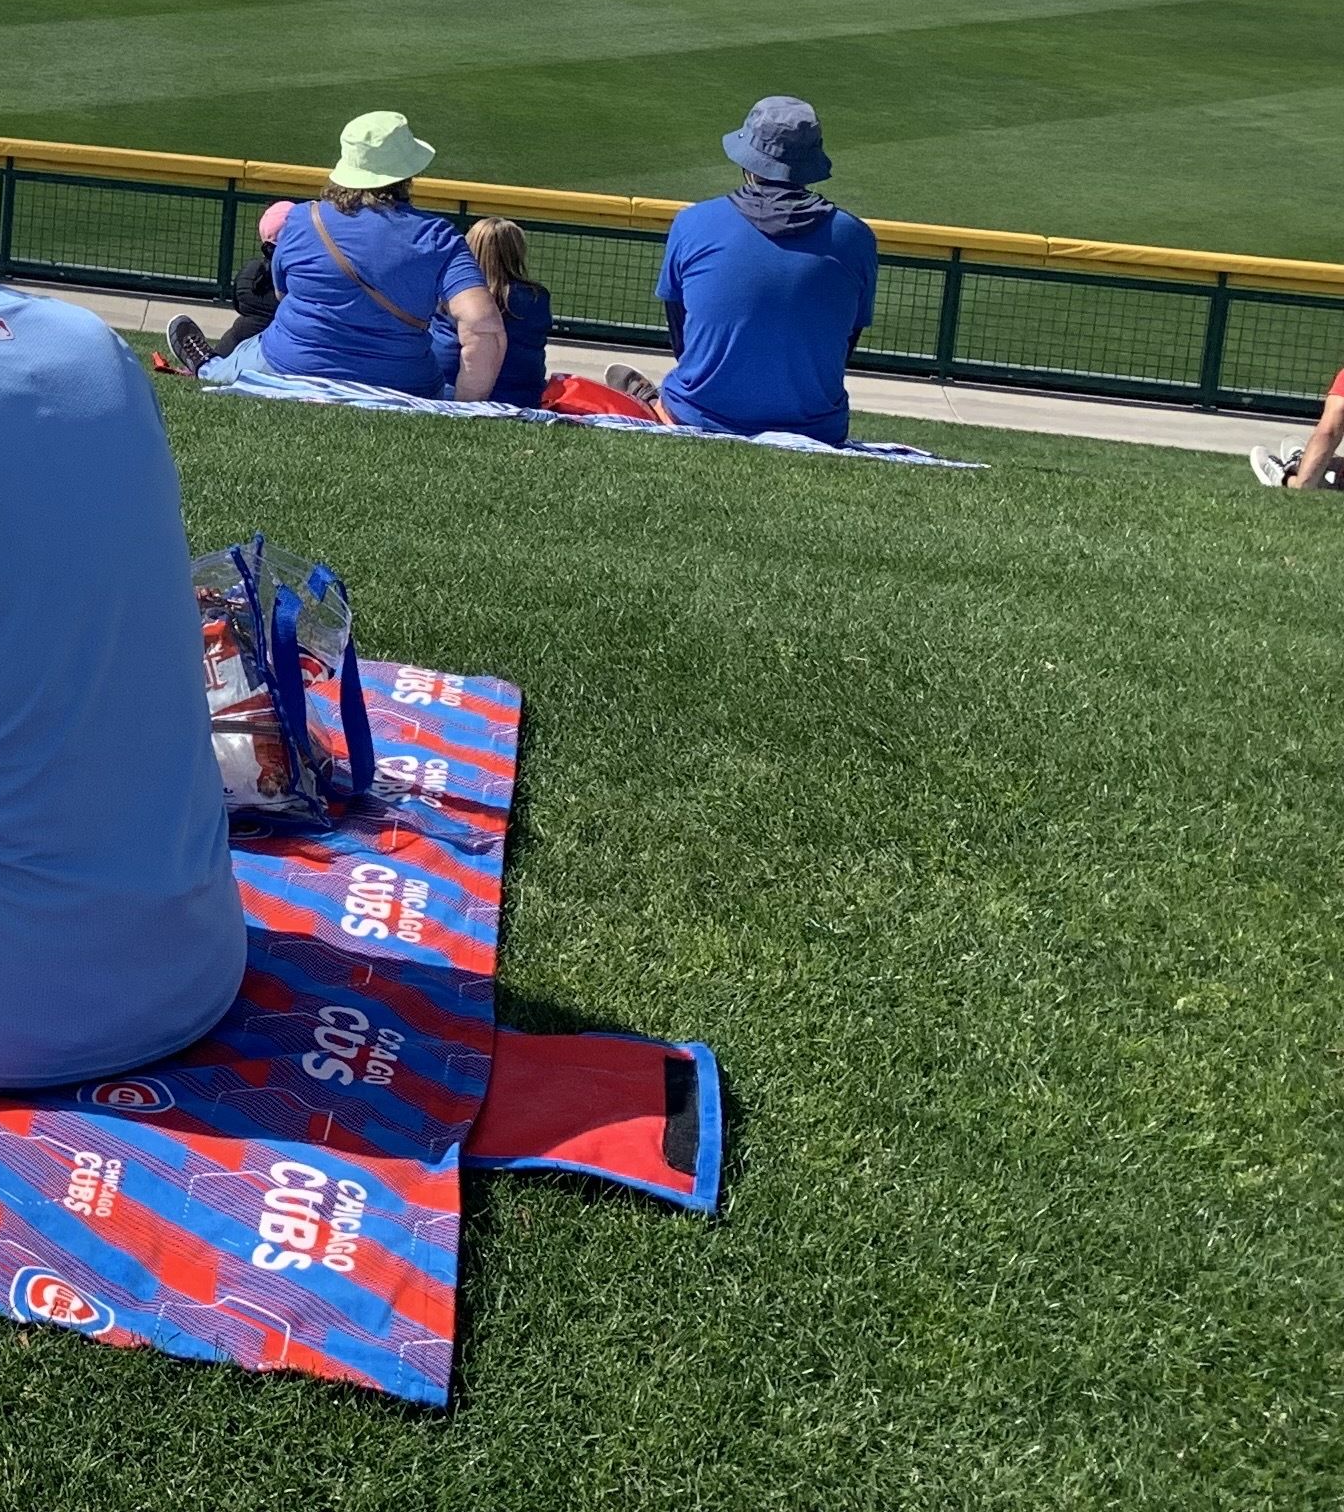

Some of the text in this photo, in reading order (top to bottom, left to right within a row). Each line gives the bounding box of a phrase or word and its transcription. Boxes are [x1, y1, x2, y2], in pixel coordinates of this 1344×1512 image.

[341, 863, 398, 940] CUBS
[397, 878, 430, 944] CHICAGO
[63, 1151, 103, 1217] CUBS
[95, 1159, 122, 1218] CHICAGO
[251, 1161, 329, 1272] CUBS
[321, 1179, 368, 1272] CHICAGO
